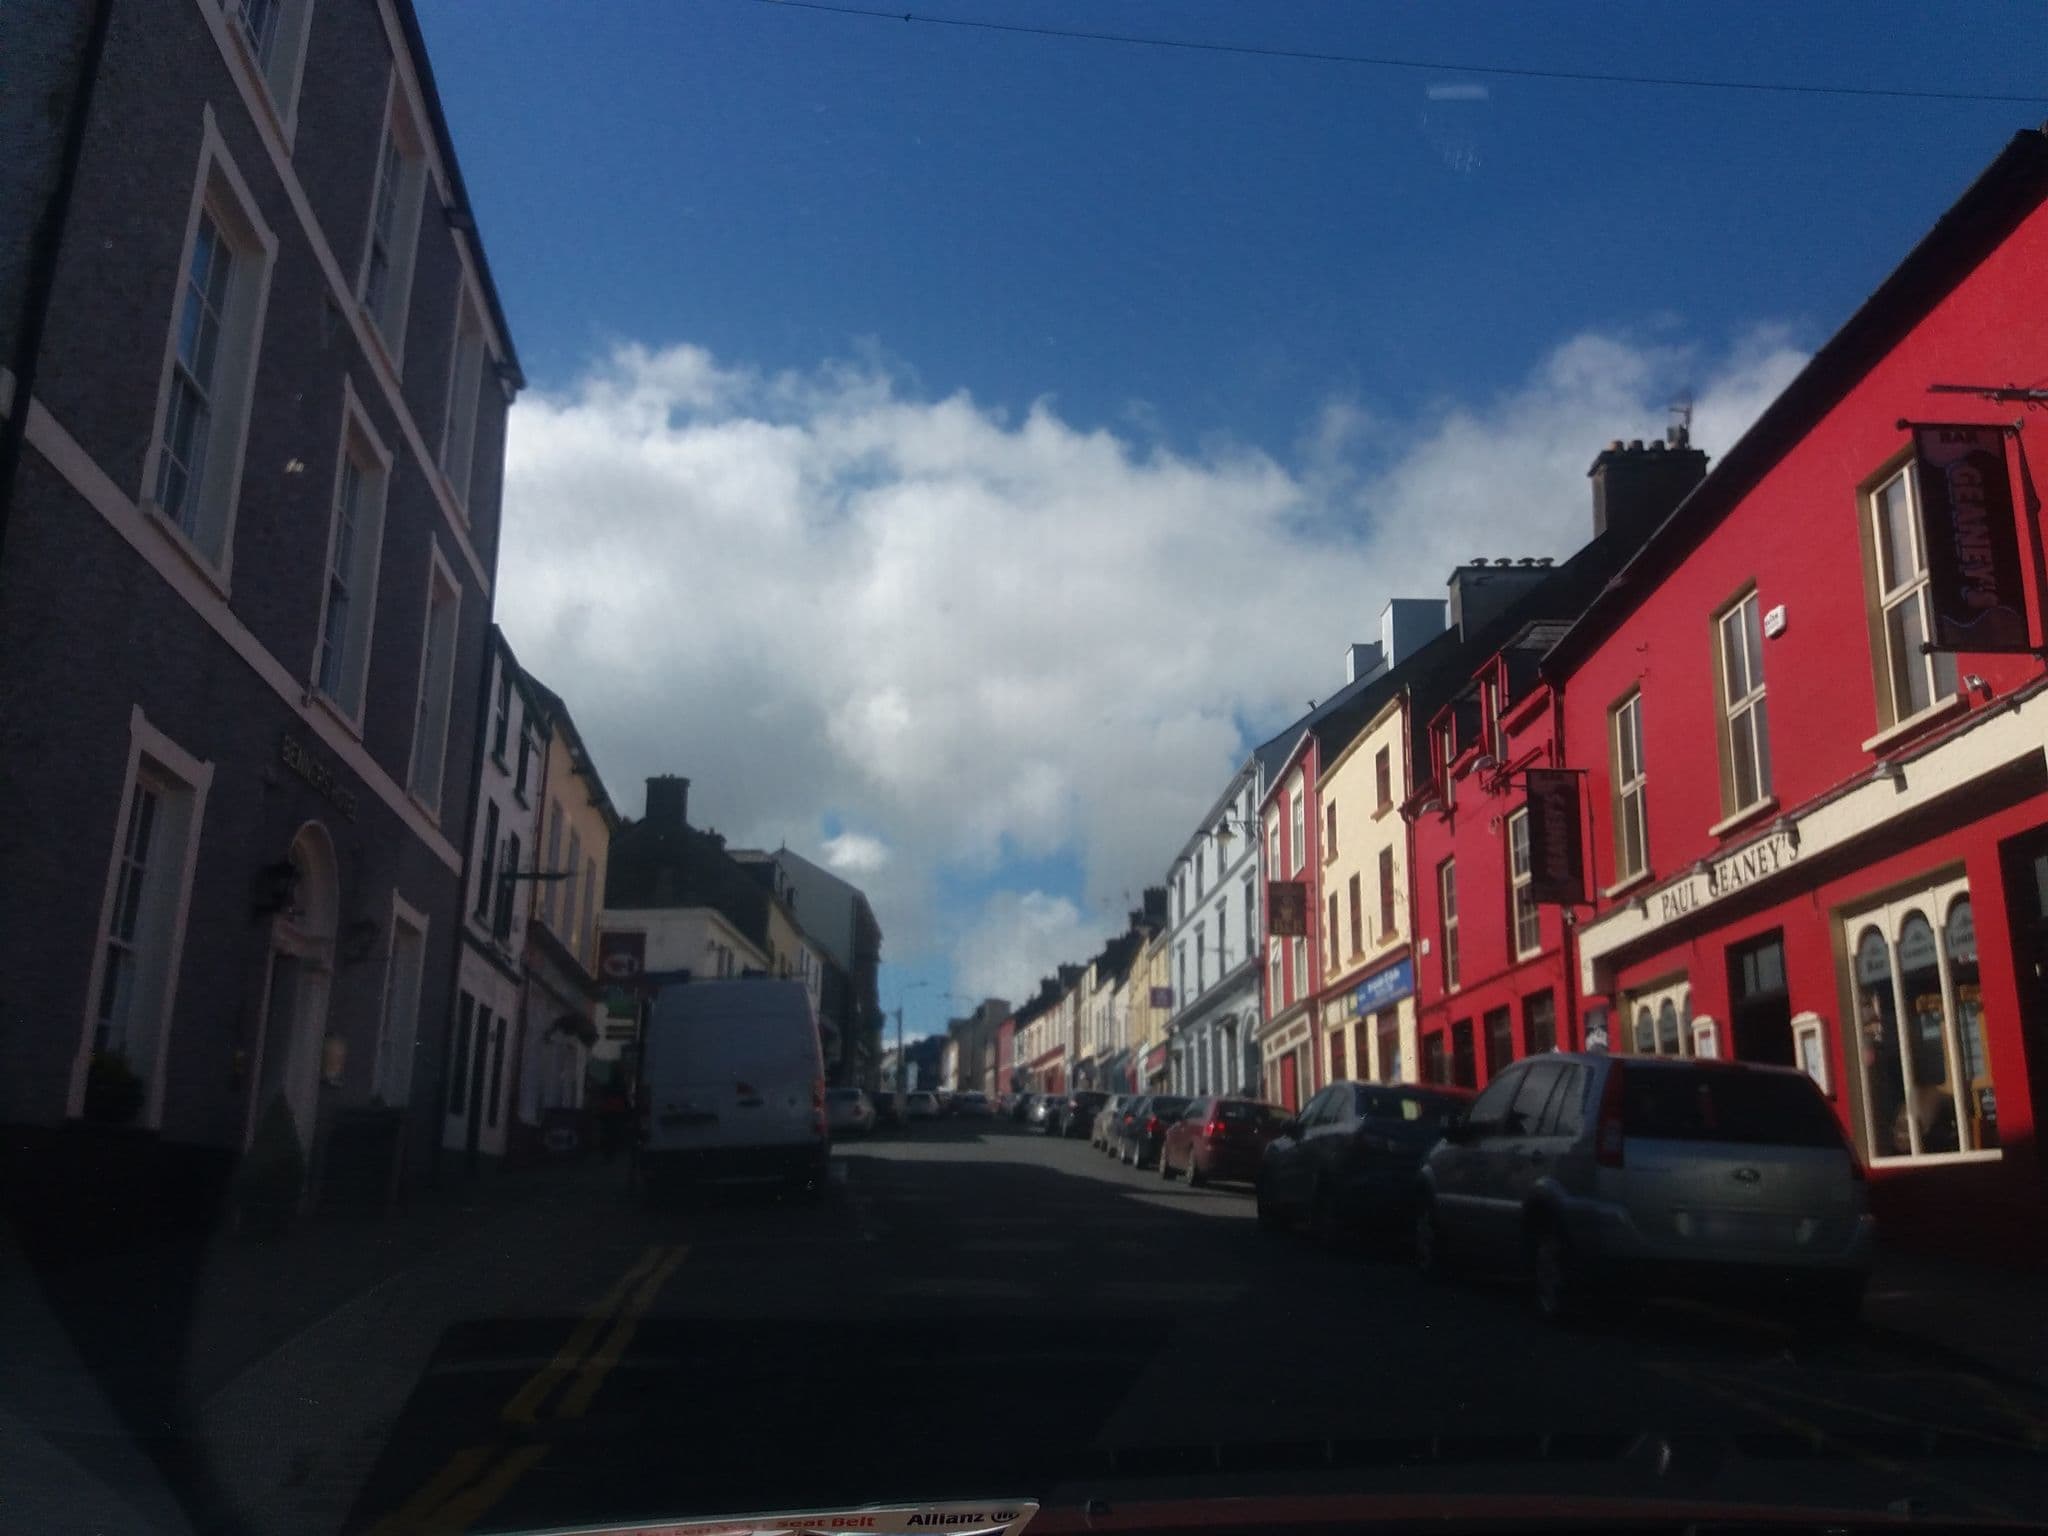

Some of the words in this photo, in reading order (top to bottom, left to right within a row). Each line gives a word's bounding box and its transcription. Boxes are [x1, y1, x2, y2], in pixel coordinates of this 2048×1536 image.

[1939, 431, 1977, 444] BAR
[1660, 881, 1700, 918] PAUL
[776, 1518, 825, 1528] Seat
[831, 1516, 876, 1528] Belt
[906, 1511, 985, 1526] Allianz
